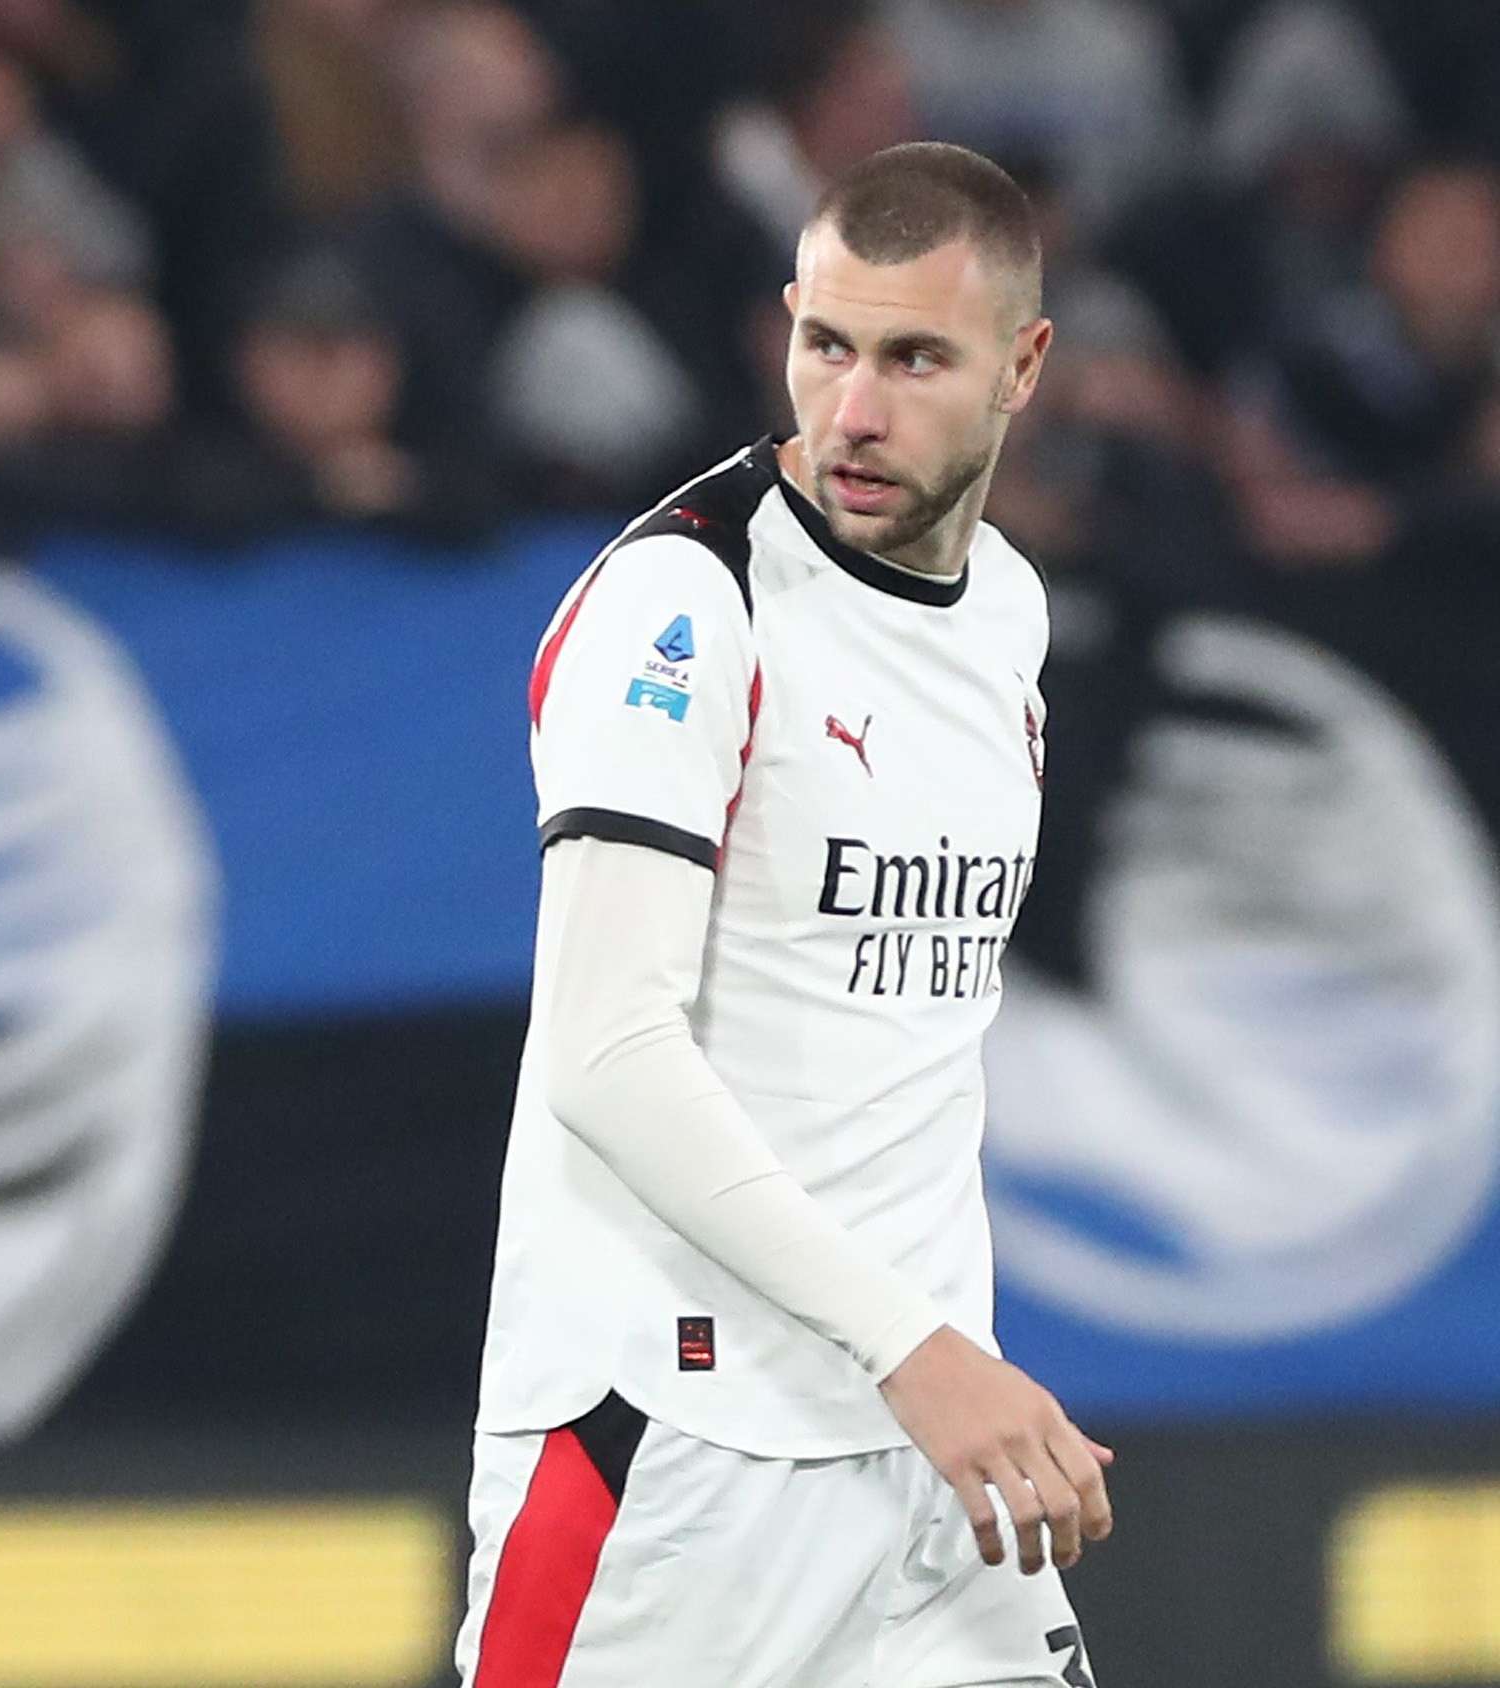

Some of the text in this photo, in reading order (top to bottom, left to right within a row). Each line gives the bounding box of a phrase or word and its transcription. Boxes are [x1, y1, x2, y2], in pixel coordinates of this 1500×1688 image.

[645, 661, 689, 681] SERIE A
[848, 933, 1009, 998] FLY BETT
